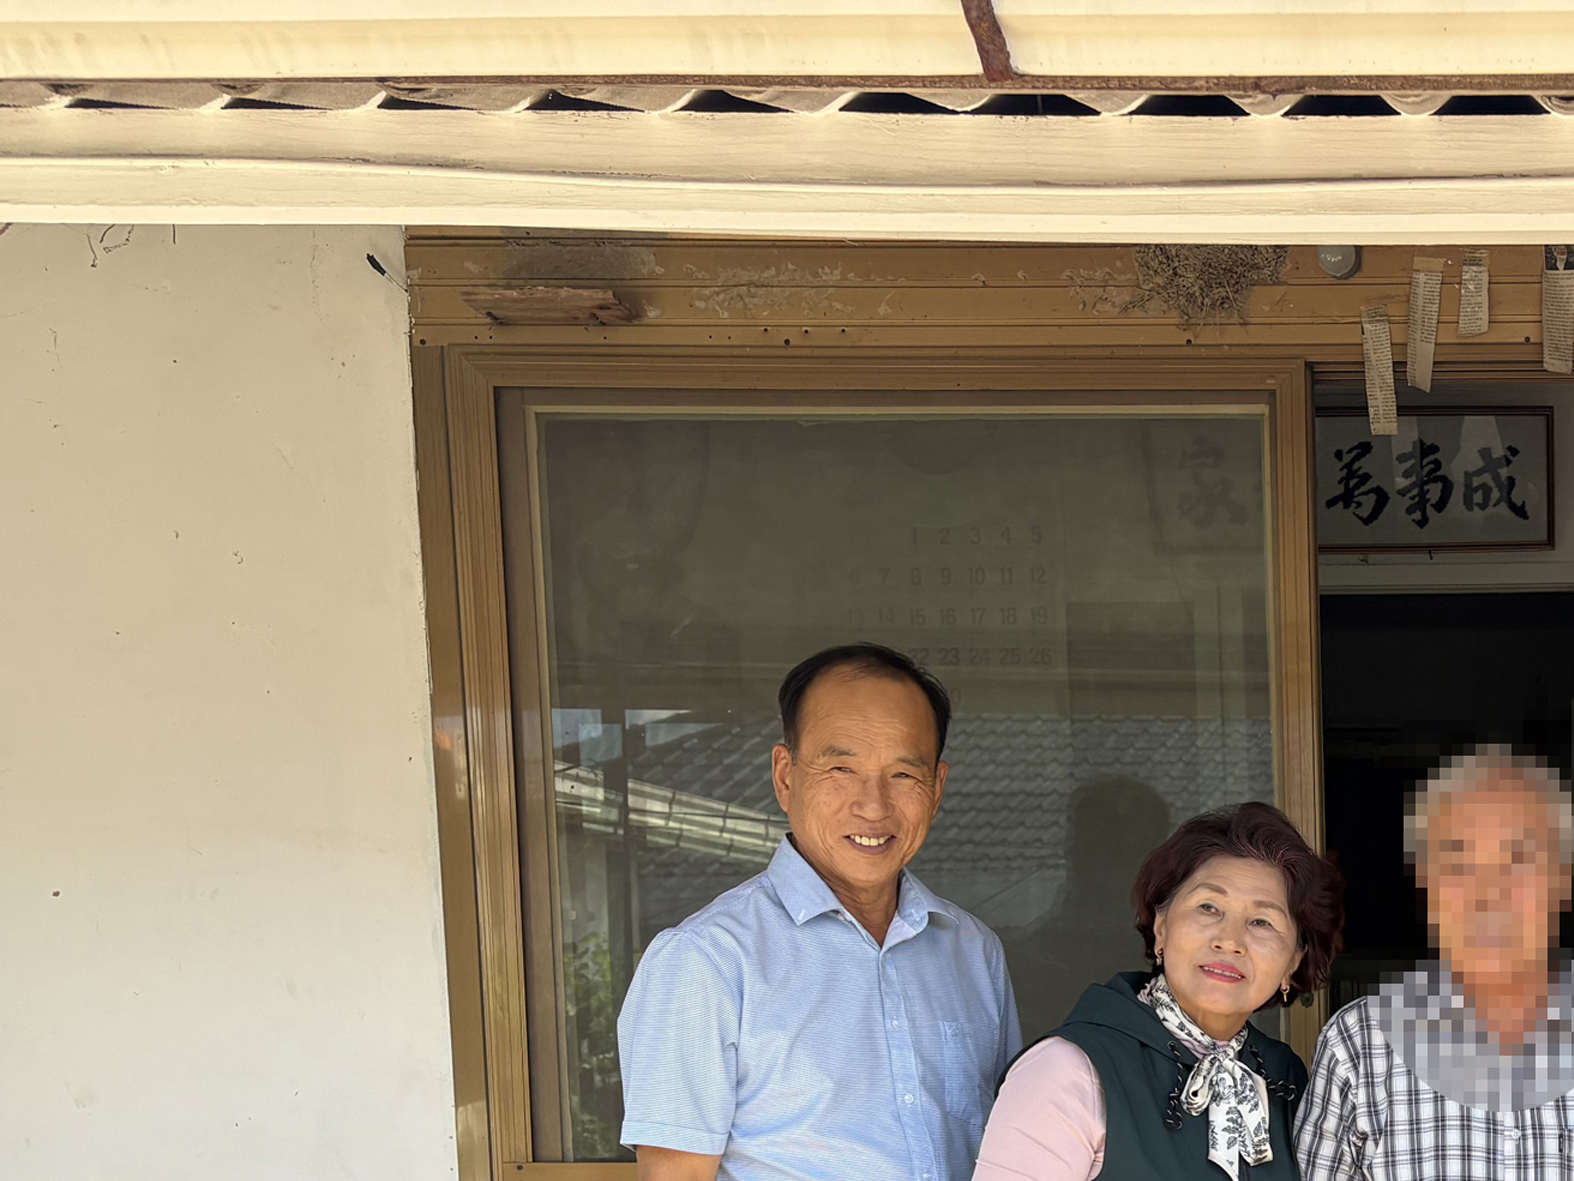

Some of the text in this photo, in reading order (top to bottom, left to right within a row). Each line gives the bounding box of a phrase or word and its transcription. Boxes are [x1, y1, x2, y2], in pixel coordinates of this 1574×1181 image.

[939, 527, 951, 545] 2
[970, 527, 982, 545] 3
[1000, 527, 1012, 545] 4
[1031, 526, 1043, 545] 5
[879, 567, 891, 585] 7
[910, 567, 922, 586] 8
[940, 567, 952, 586] 9
[968, 567, 986, 585] 10
[999, 567, 1014, 585] 11
[1029, 567, 1047, 585] 12
[877, 608, 895, 627] 14
[909, 608, 926, 627] 15
[939, 608, 957, 627] 16
[970, 608, 987, 626] 17
[1000, 607, 1018, 626] 18
[1030, 607, 1048, 626] 19
[938, 648, 960, 666] 23
[968, 648, 990, 665] 24
[999, 648, 1021, 665] 25
[1029, 648, 1052, 665] 26
